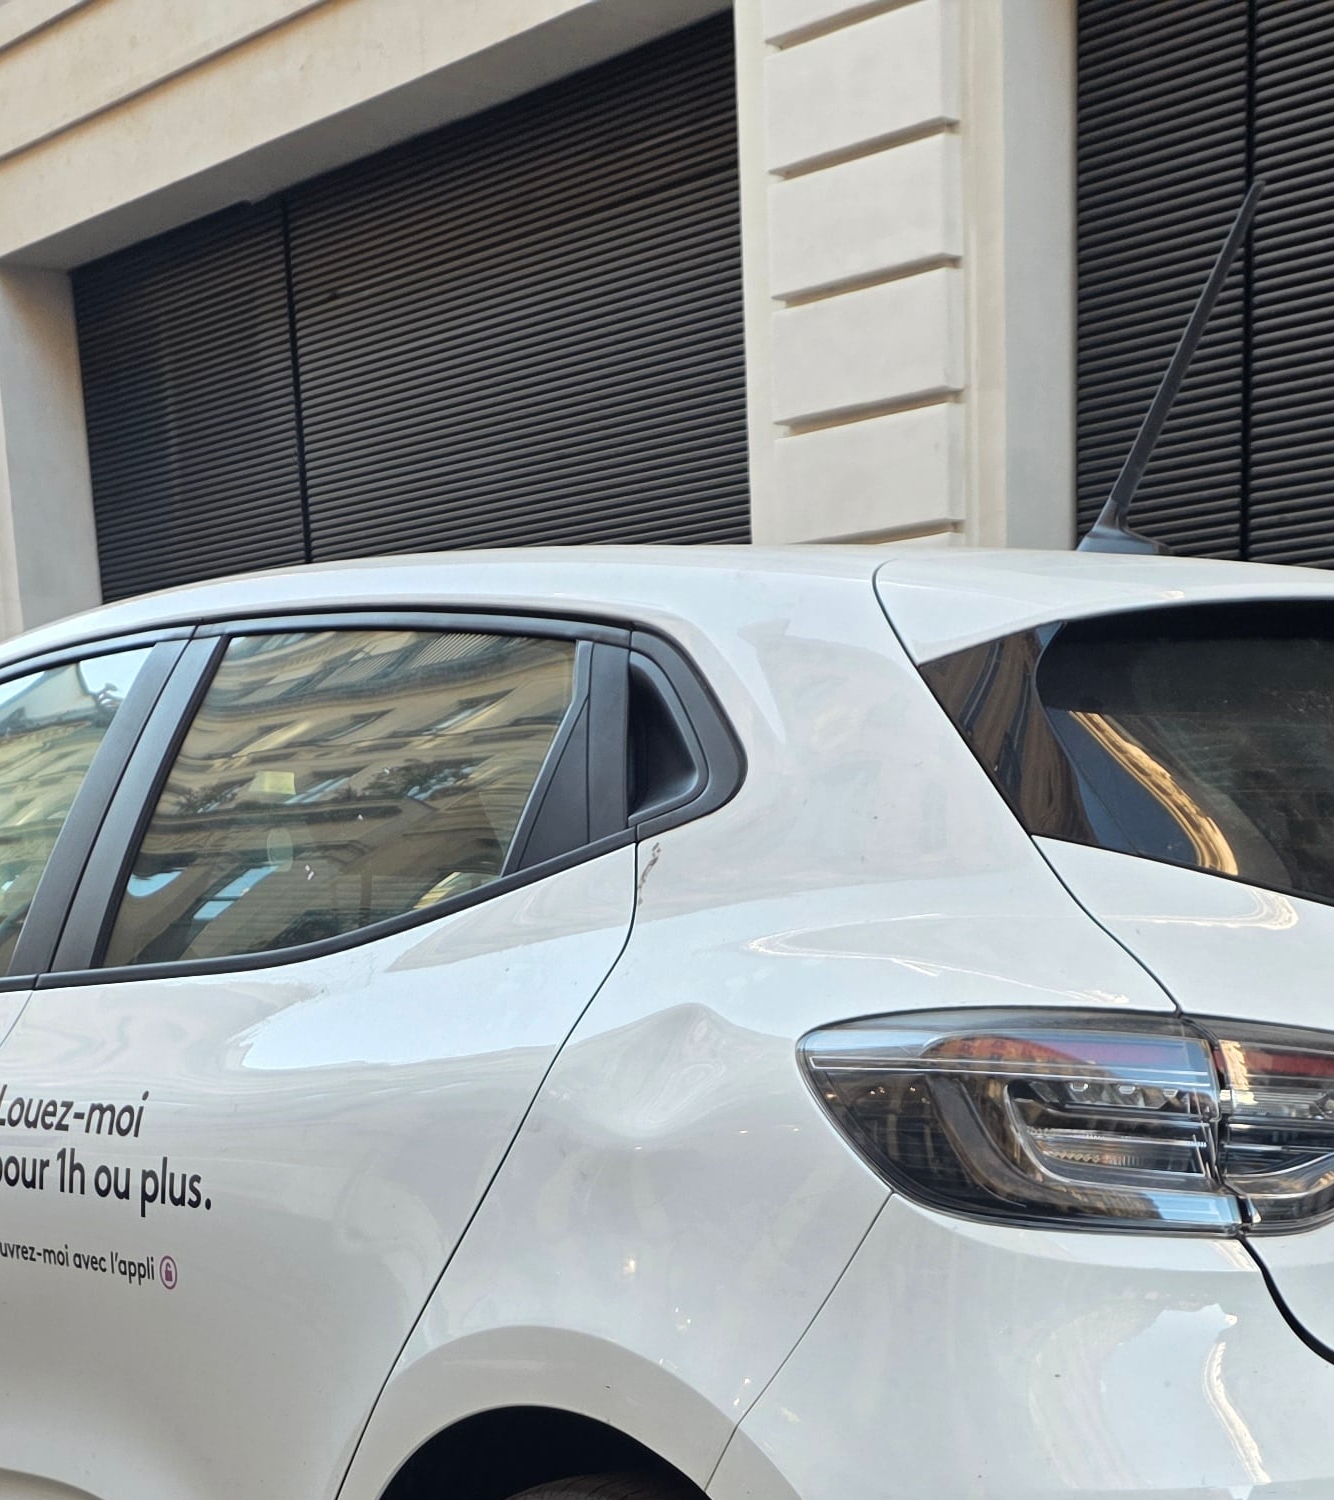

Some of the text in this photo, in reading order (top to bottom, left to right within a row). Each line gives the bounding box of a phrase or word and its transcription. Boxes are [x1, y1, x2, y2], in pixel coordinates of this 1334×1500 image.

[56, 1147, 85, 1195] 1h
[94, 1165, 131, 1200] ou
[140, 1156, 212, 1218] plus.
[73, 1253, 107, 1273] avec
[110, 1251, 155, 1286] l'appli
